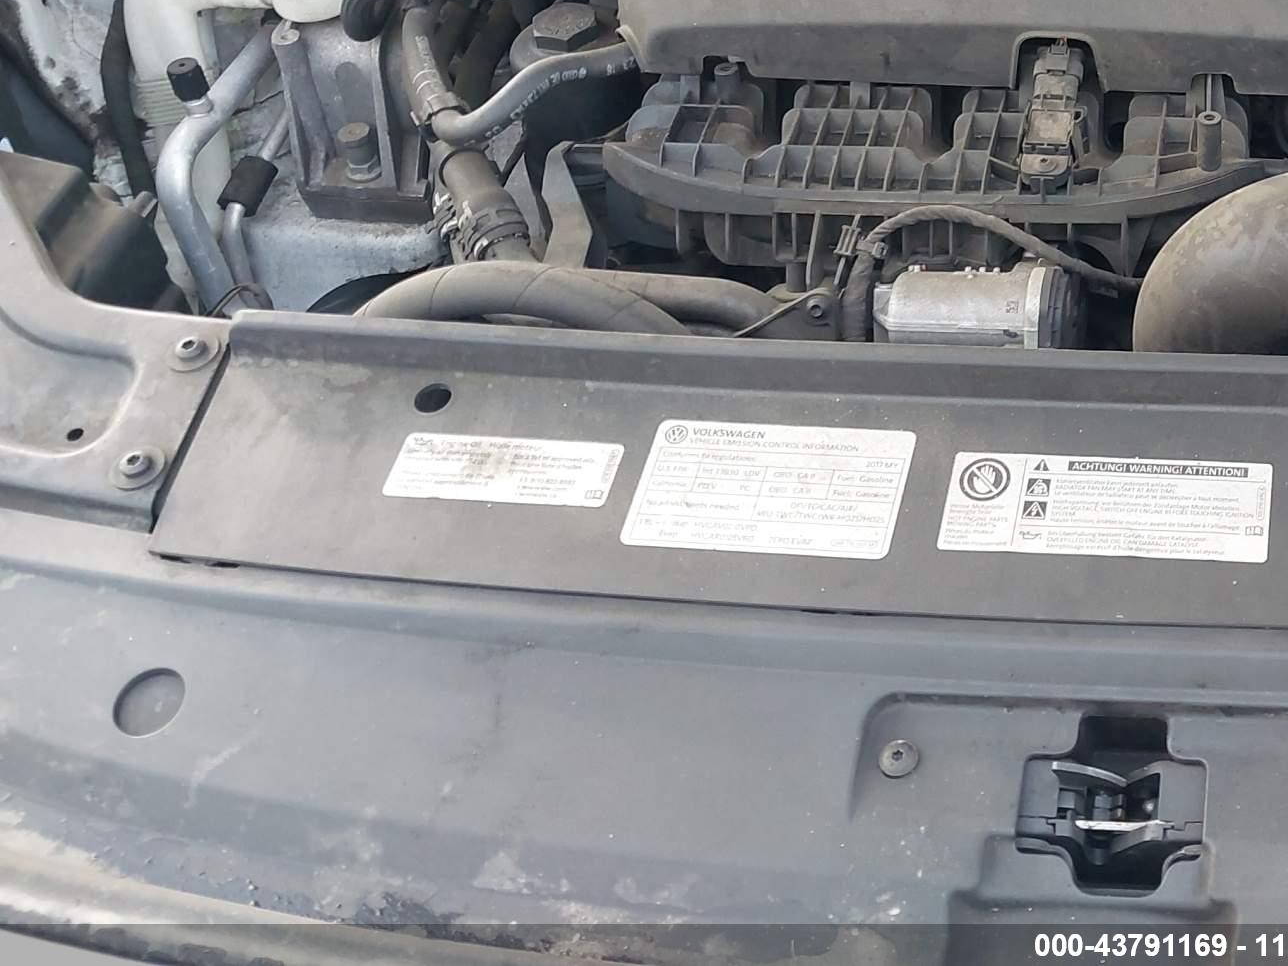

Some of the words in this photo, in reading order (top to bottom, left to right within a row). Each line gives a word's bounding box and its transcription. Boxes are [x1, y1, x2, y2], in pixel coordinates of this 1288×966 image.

[693, 427, 766, 439] VOLKSWAGEN
[762, 441, 799, 450] CONTROL
[802, 442, 859, 452] INFORMATION
[1071, 462, 1127, 472] ACHTUNG!
[1129, 464, 1183, 475] WARNING!
[1185, 466, 1245, 477] ATTENTION!
